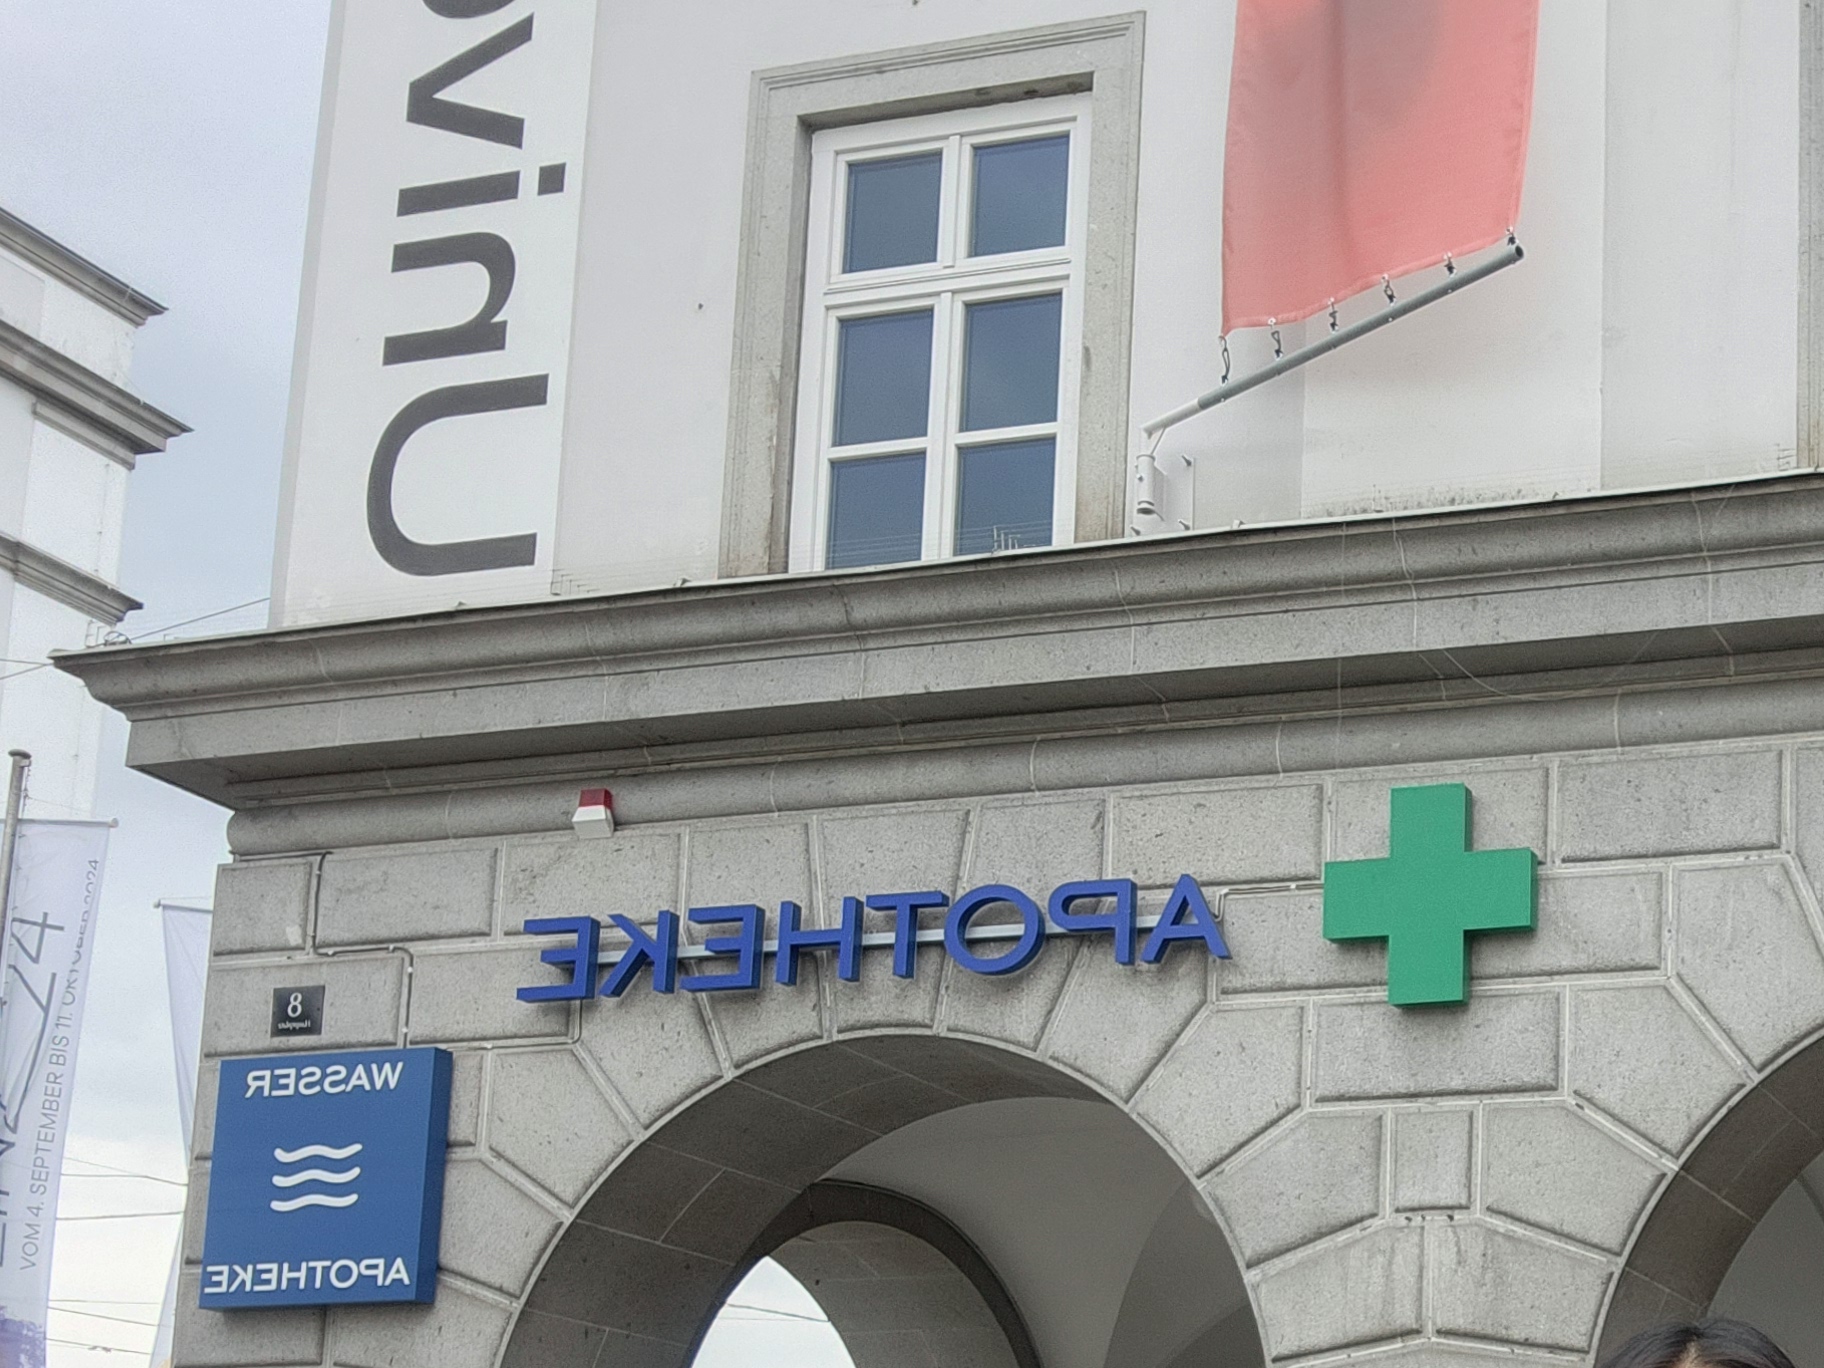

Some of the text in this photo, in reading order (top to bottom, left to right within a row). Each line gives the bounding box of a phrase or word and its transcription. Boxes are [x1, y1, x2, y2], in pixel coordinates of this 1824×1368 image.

[55, 1013, 72, 1029] 11.
[48, 1036, 69, 1066] BIS
[29, 1072, 64, 1195] SEPTEMBER
[20, 1221, 41, 1269] VOM
